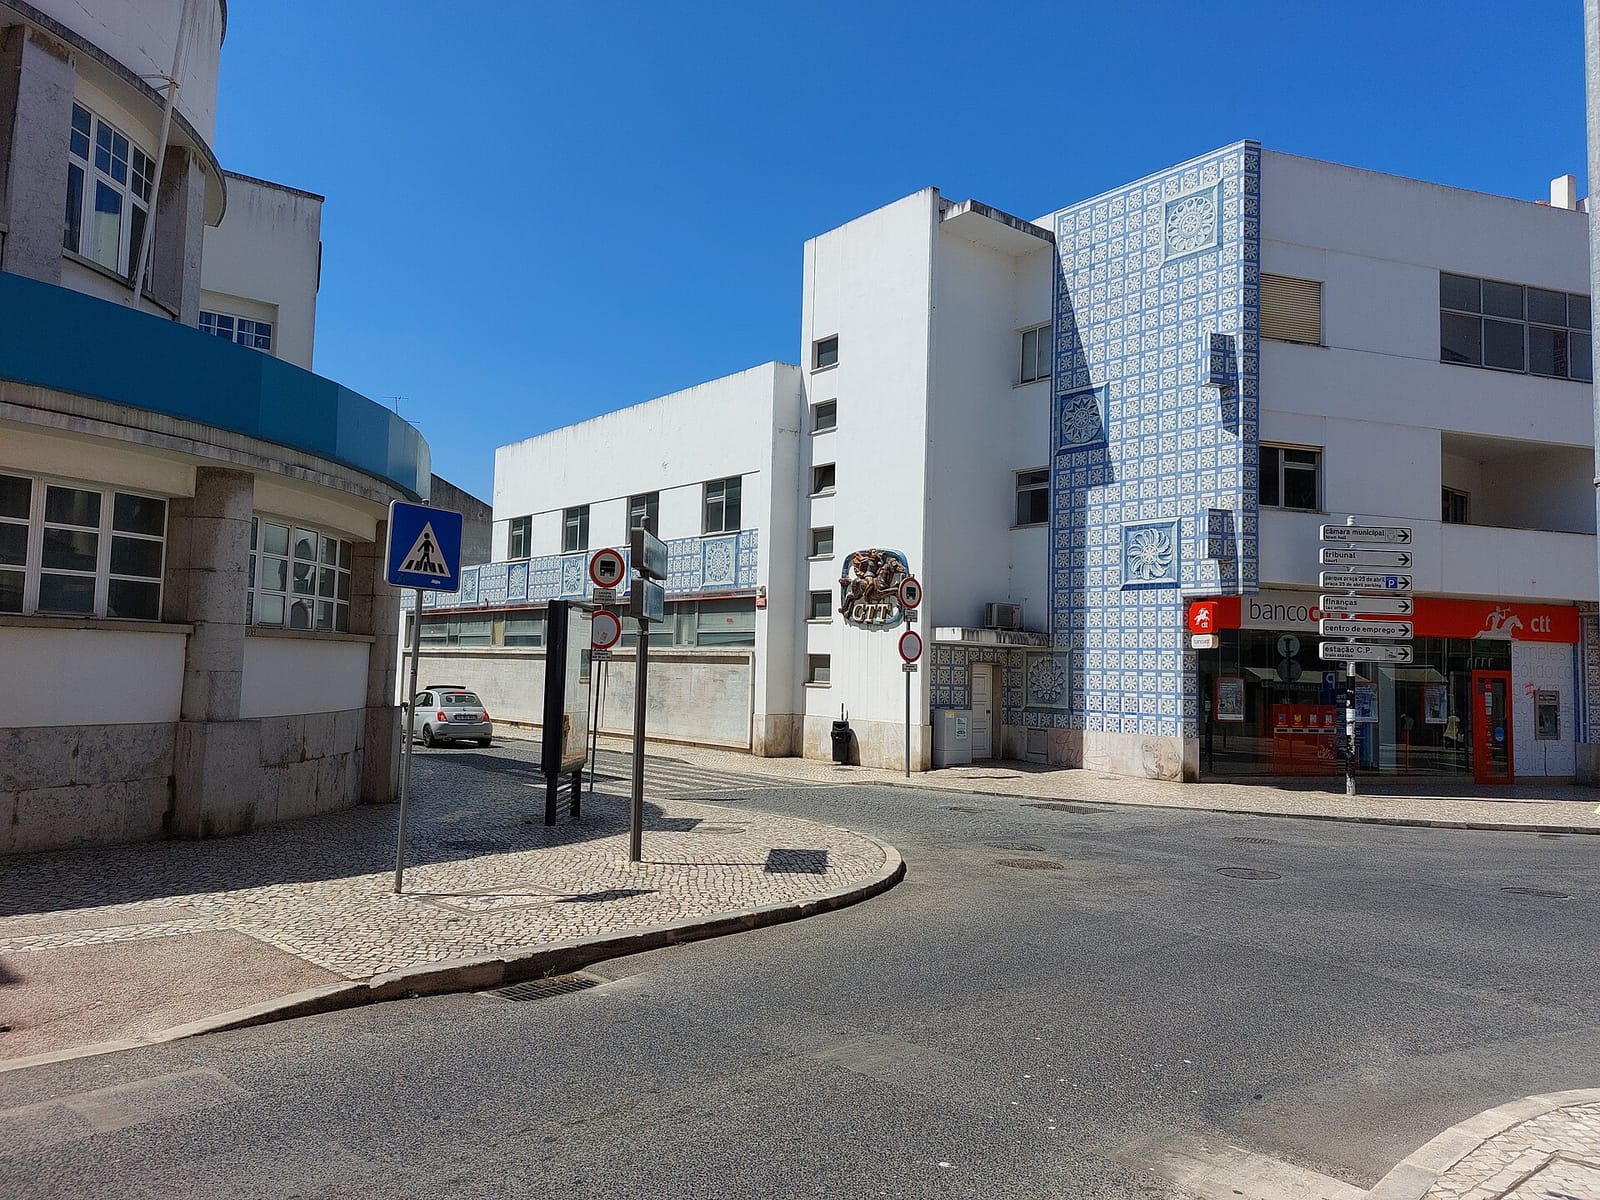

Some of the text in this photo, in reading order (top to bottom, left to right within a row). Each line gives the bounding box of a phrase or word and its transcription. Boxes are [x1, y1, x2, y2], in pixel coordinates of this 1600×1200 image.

[1325, 598, 1358, 606] finanças
[852, 603, 891, 622] CTT
[1249, 598, 1332, 622] bancoc
[1362, 626, 1396, 634] emprego
[1530, 615, 1551, 633] ctt
[1325, 646, 1355, 654] estação
